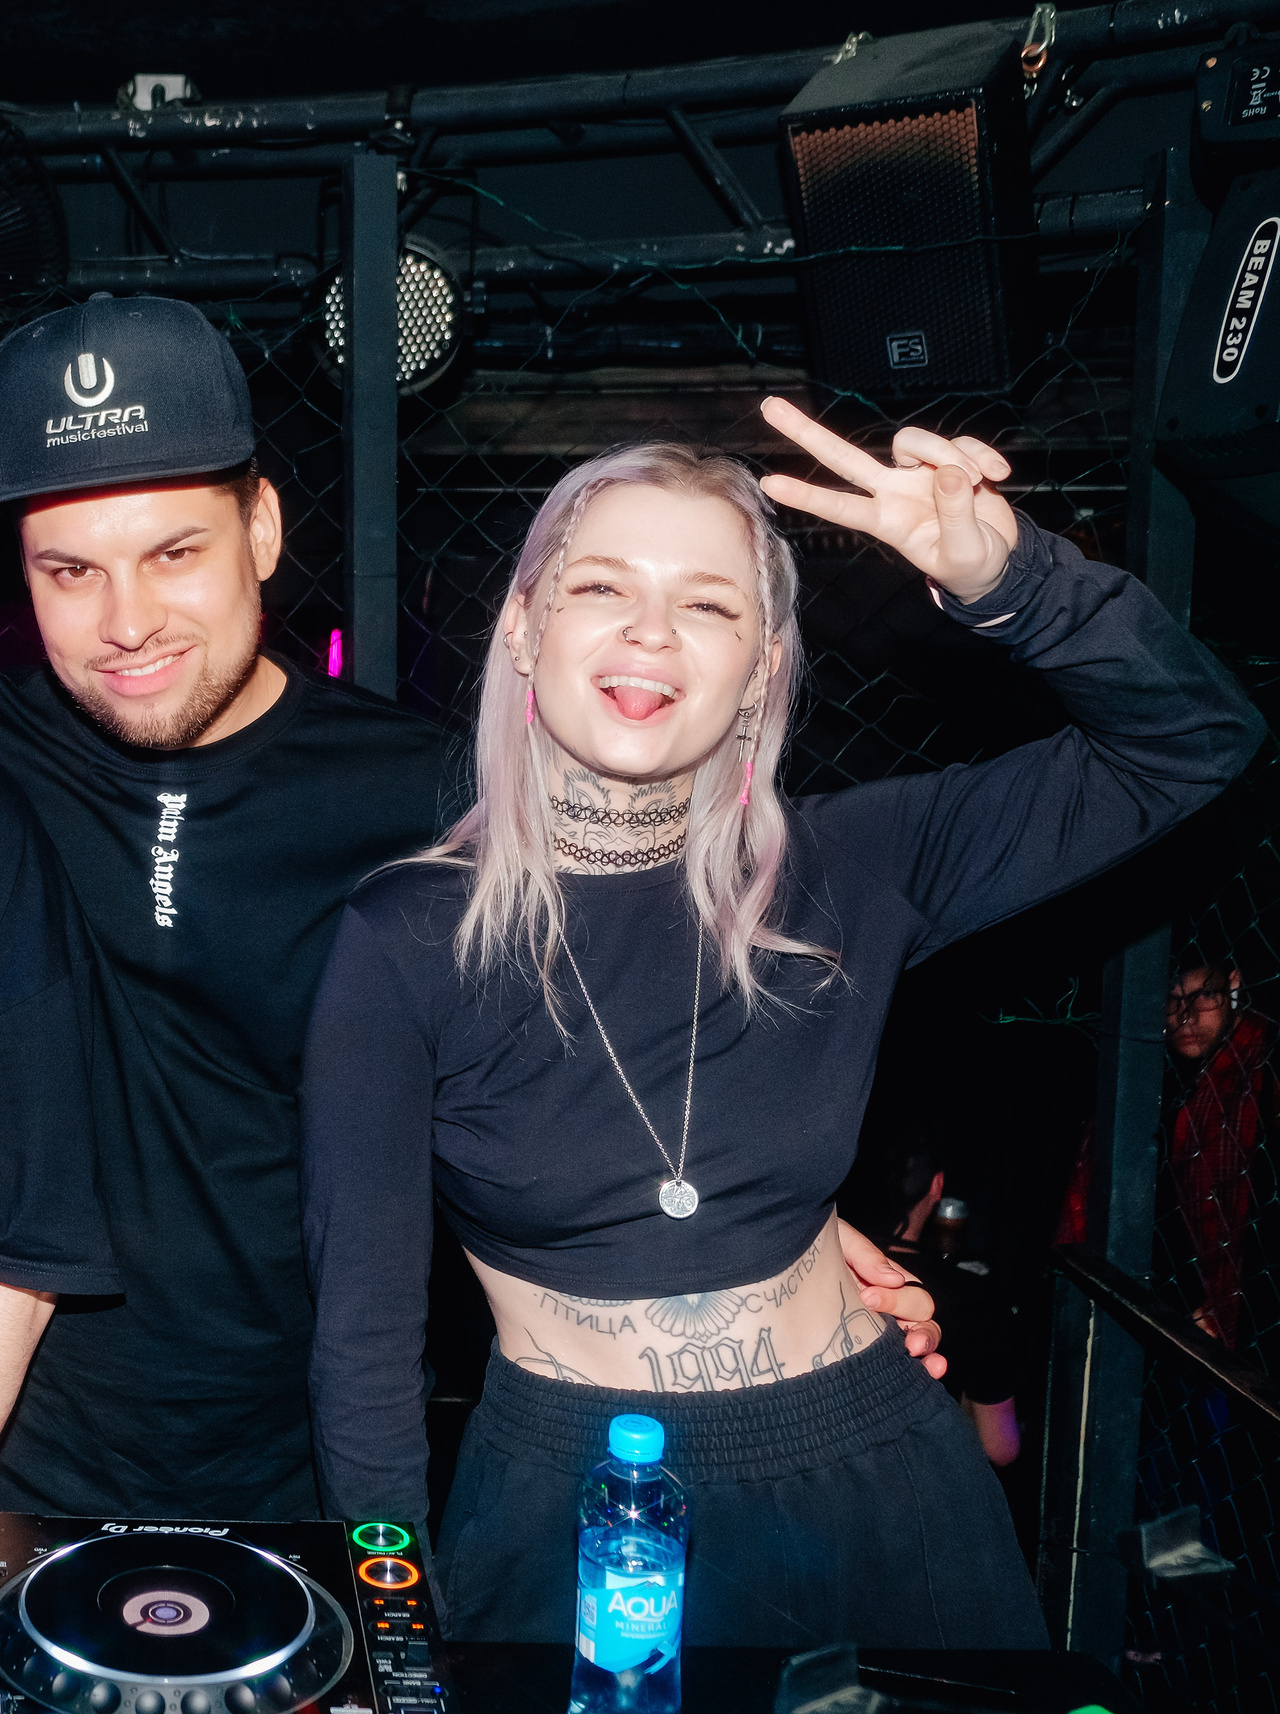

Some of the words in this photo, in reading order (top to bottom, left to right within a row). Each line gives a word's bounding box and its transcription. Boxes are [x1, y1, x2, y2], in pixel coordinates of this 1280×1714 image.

[1250, 66, 1270, 81] CE
[1242, 106, 1267, 118] RoHS
[1235, 239, 1272, 309] BEAM
[890, 337, 924, 364] FS
[1222, 316, 1247, 362] 230
[45, 404, 146, 435] ULTRA
[46, 420, 149, 448] musicfestival
[157, 792, 188, 843] Palm
[149, 845, 180, 928] Angels
[539, 1292, 637, 1340] ПТИЦА
[745, 1243, 820, 1313] СЧАСТЬЯ
[639, 1327, 785, 1392] 1994
[133, 1525, 230, 1537] Pioneer
[608, 1590, 678, 1622] AQUA
